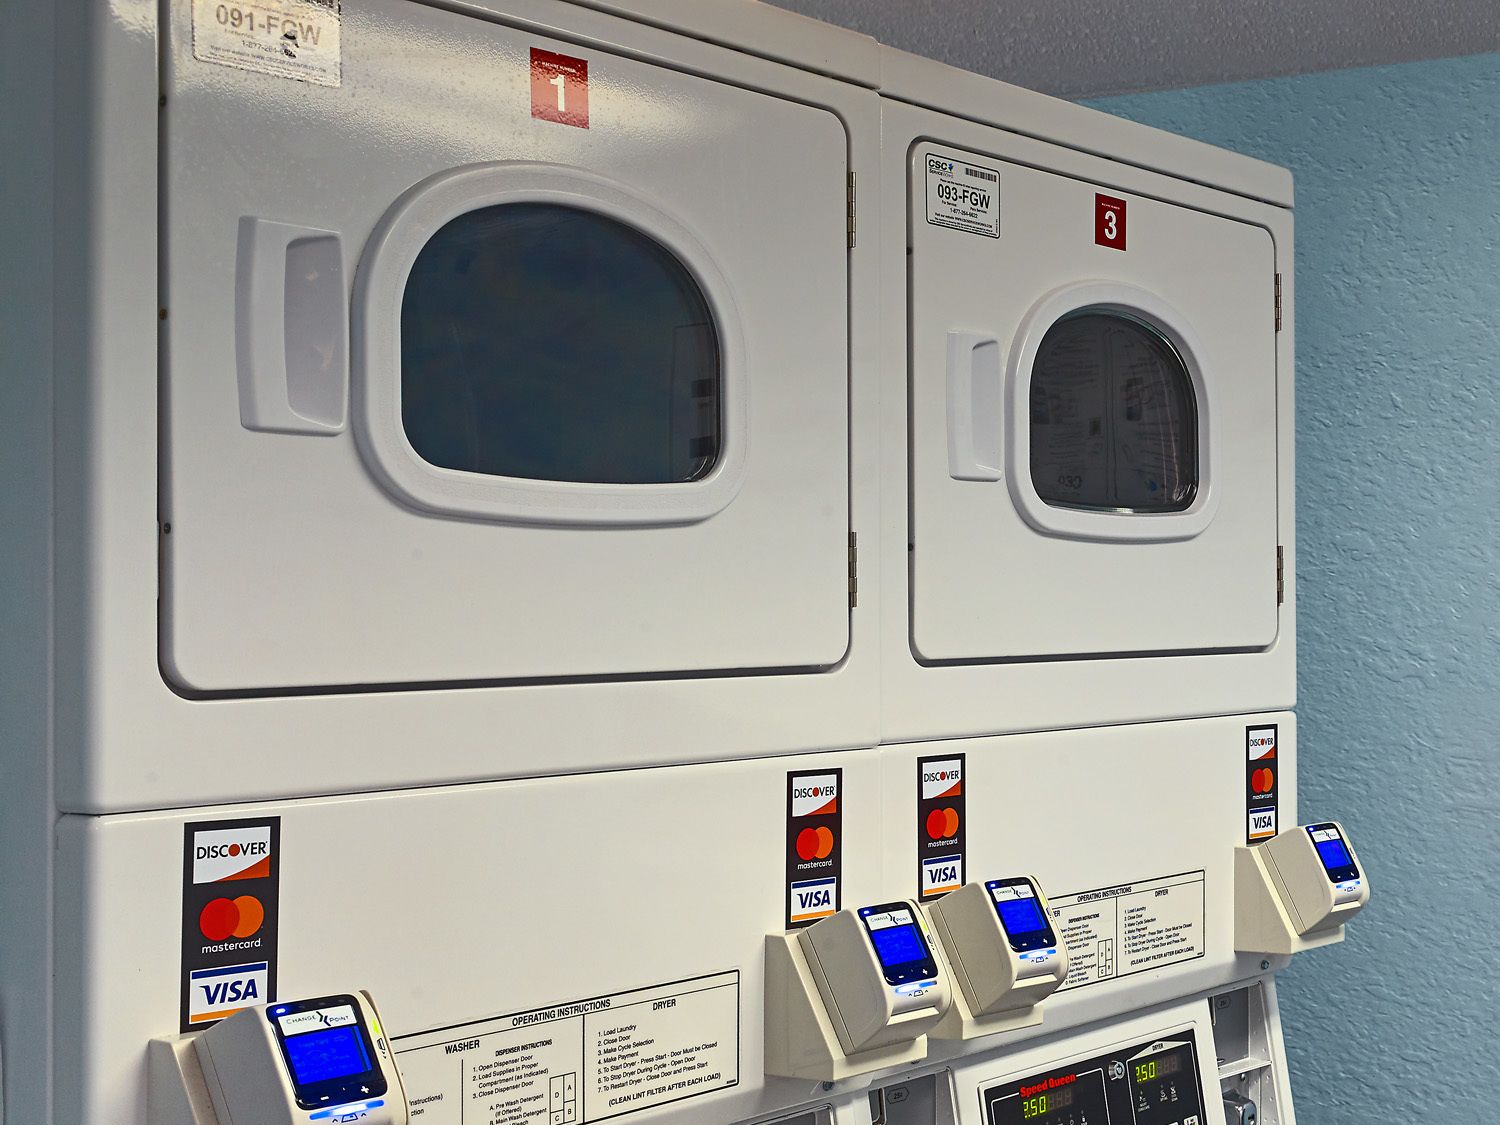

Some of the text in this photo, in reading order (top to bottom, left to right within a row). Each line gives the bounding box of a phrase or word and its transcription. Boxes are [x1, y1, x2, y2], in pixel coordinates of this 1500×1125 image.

[550, 74, 565, 111] 1
[928, 158, 946, 170] CSC
[937, 182, 990, 209] 093-FGW
[1105, 211, 1116, 239] 3
[1250, 738, 1274, 746] DISCOVER
[924, 770, 960, 782] DISCOVER
[794, 786, 835, 798] DISCOVER
[1252, 816, 1272, 829] VISA
[197, 841, 268, 860] DISCOVER
[928, 838, 958, 848] mastercard
[798, 860, 832, 869] mastercard
[928, 865, 957, 883] VISA
[797, 890, 830, 909] VISA
[202, 938, 262, 954] mastercard
[200, 979, 258, 1005] VISA
[652, 997, 676, 1011] DRYER
[286, 1015, 316, 1024] CHANGE
[512, 1000, 610, 1026] OPERATING INSTRUCTIONS
[603, 1028, 615, 1036] Load
[618, 1034, 630, 1042] Door
[445, 1038, 479, 1055] WASHER
[478, 1063, 492, 1072] Open
[608, 1094, 631, 1107] (CLEAN
[632, 1091, 645, 1100] LINT
[646, 1086, 665, 1097] FILTER
[667, 1080, 685, 1091] AFTER
[687, 1076, 702, 1086] EACH
[1020, 1074, 1076, 1097] Speed Queen
